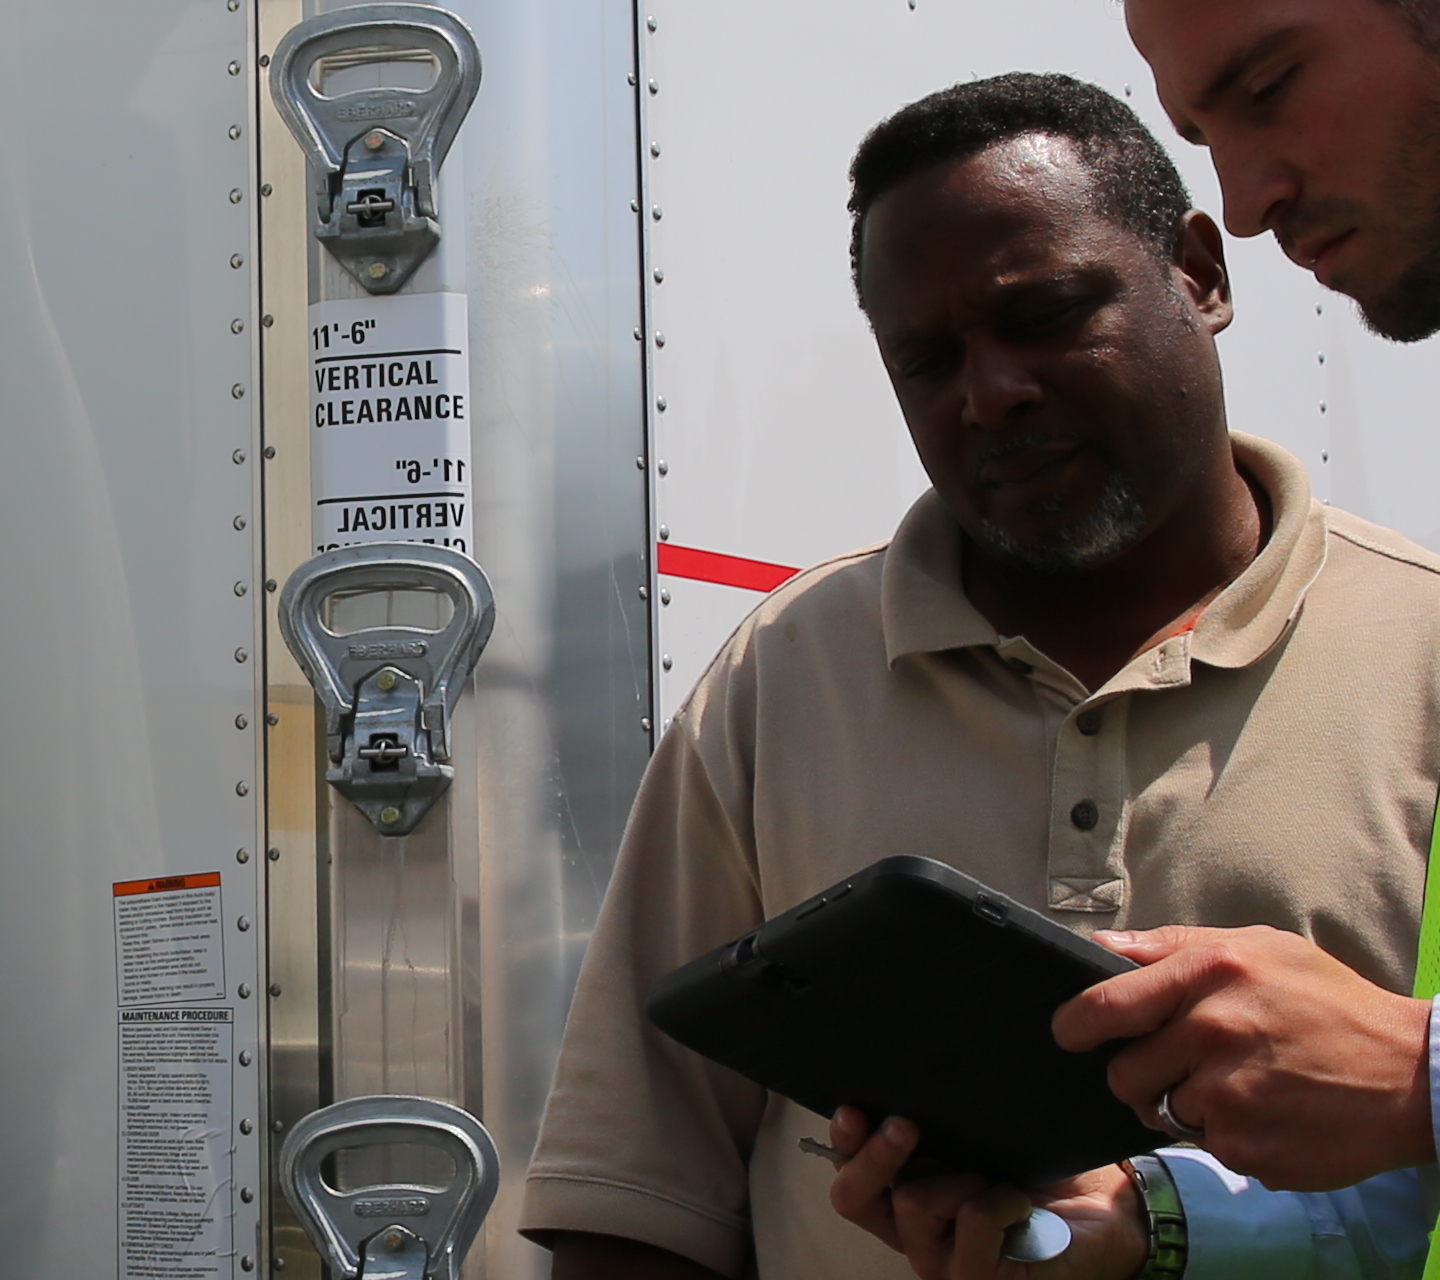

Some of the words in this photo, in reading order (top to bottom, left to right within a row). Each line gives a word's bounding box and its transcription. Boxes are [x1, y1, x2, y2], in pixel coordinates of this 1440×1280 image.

[315, 360, 438, 393] VERTICAL
[315, 395, 464, 428] CLEARANCE
[122, 1011, 180, 1021] MAINTENANCE
[182, 1010, 229, 1021] PROCEDURE
